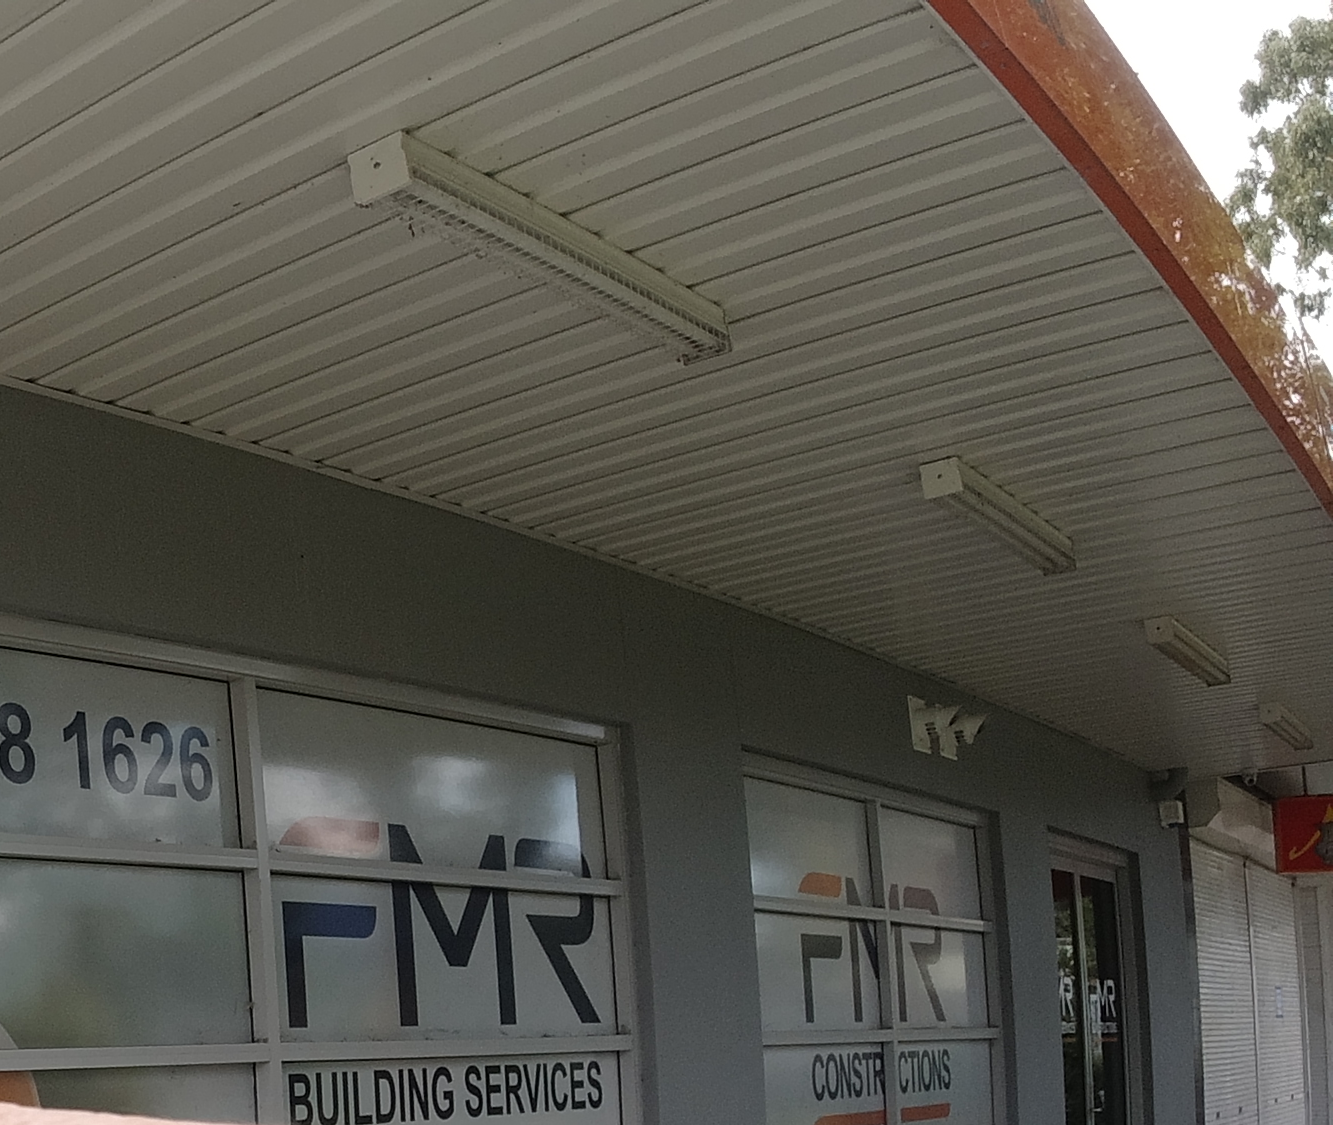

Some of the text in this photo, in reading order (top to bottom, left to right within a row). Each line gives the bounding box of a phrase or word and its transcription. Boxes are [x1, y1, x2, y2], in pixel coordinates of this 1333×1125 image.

[62, 710, 214, 802] 1626
[280, 816, 602, 1029] FMR
[464, 1060, 603, 1119] SERVICES
[811, 1049, 951, 1101] CONSTRCTIONS
